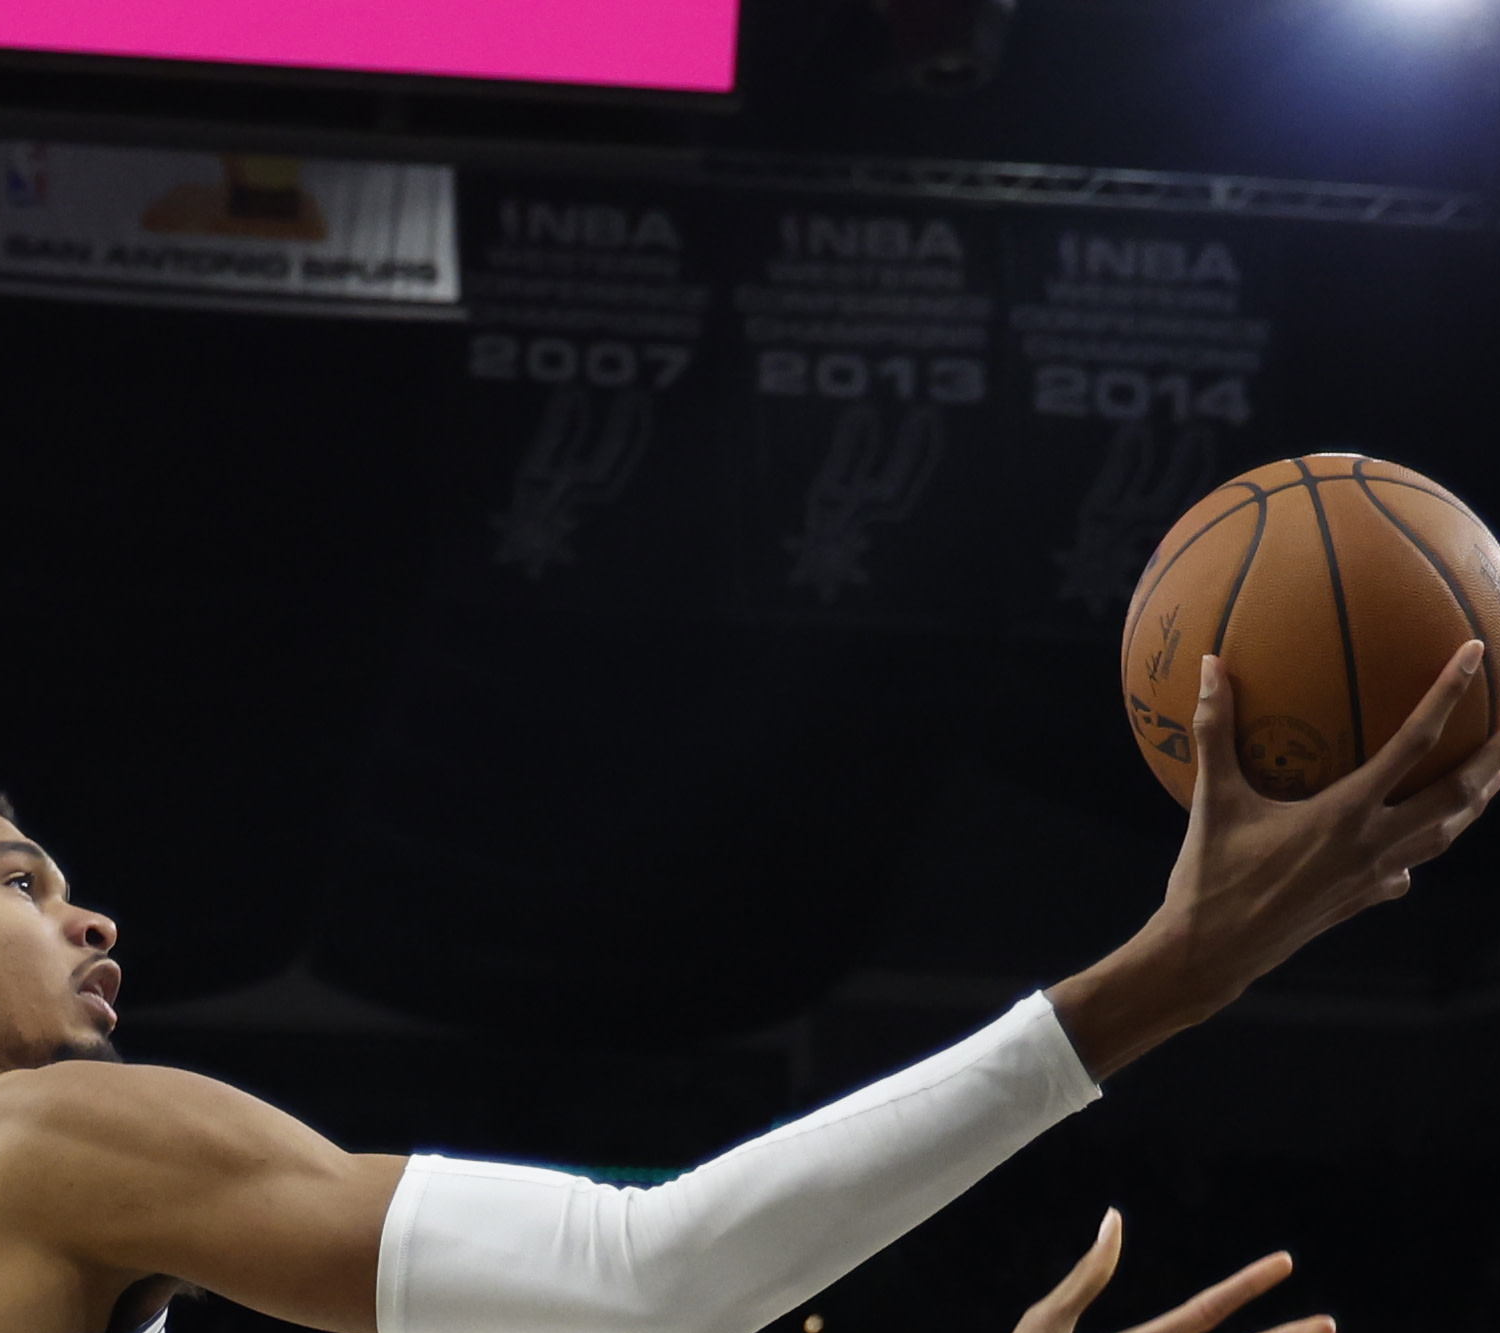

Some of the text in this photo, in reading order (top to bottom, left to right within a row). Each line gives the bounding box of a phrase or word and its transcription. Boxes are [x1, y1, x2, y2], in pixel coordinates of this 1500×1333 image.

[470, 334, 693, 389] 2007
[757, 350, 988, 406] 2013
[1032, 364, 1251, 426] 2014
